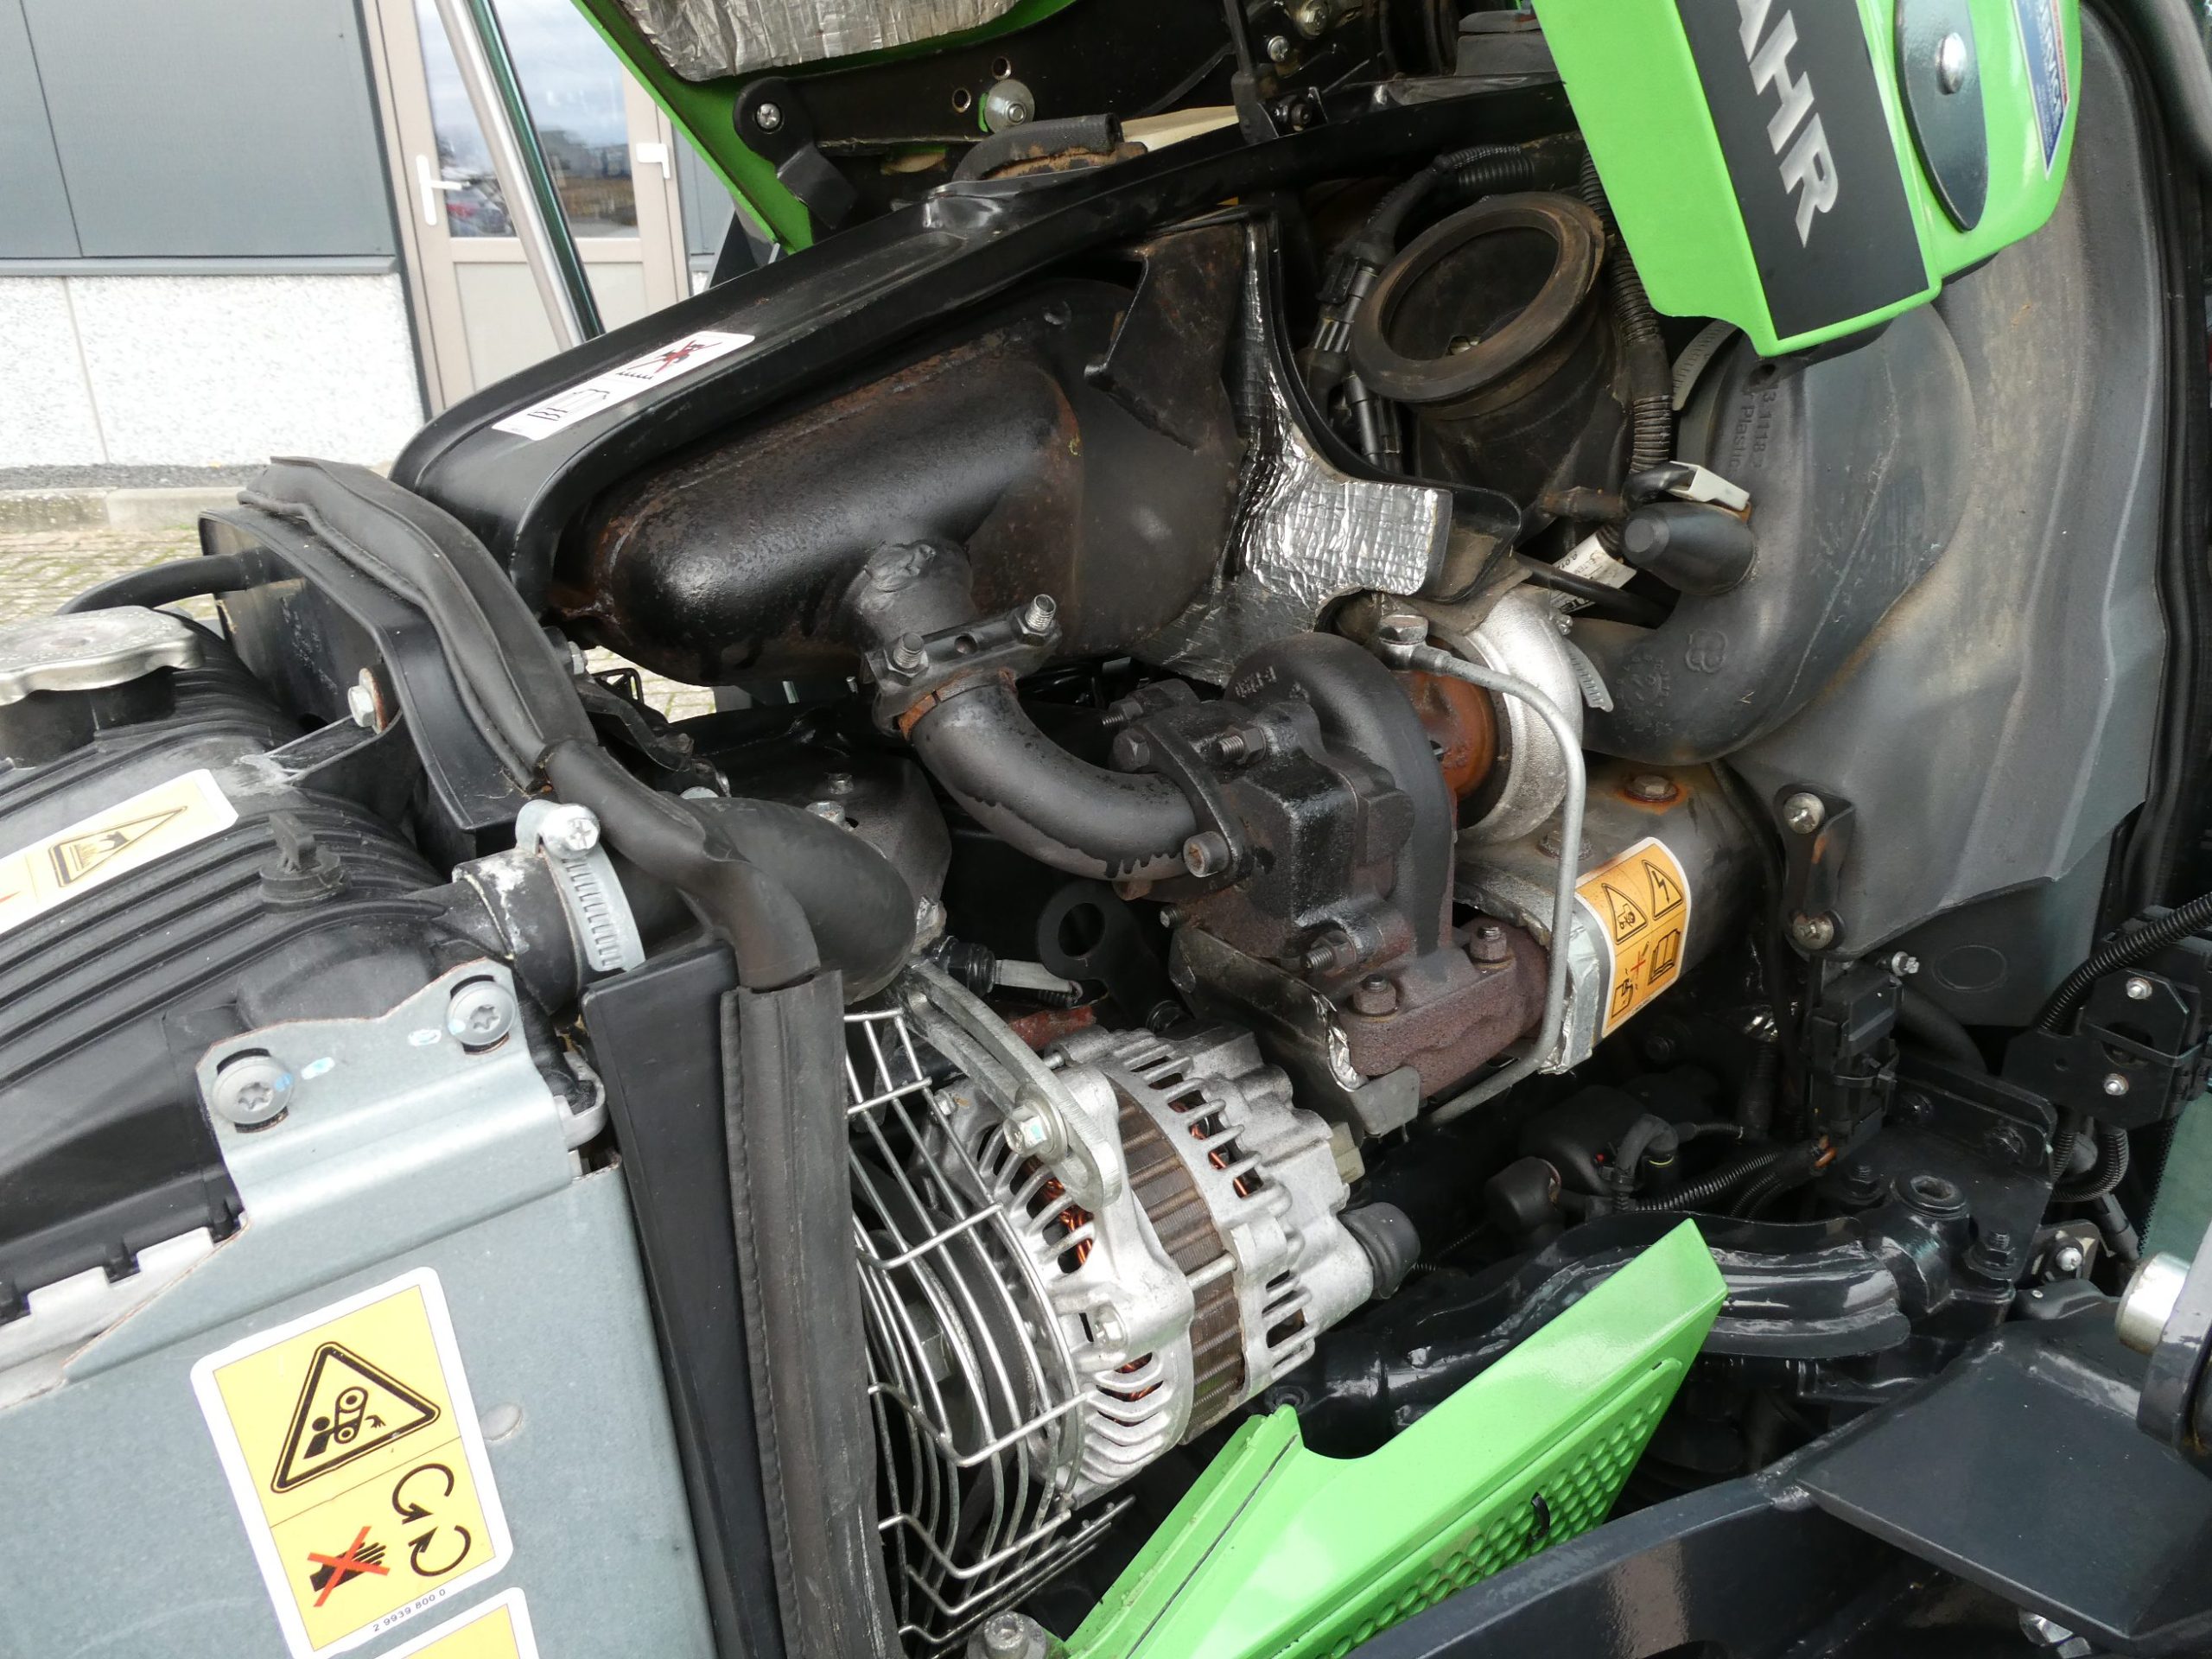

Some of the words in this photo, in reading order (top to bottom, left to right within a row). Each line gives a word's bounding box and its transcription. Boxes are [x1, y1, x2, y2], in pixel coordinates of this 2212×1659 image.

[372, 1624, 380, 1632] 2
[383, 1606, 411, 1626] 9939
[415, 1594, 435, 1609] 800
[439, 1588, 446, 1597] 0
